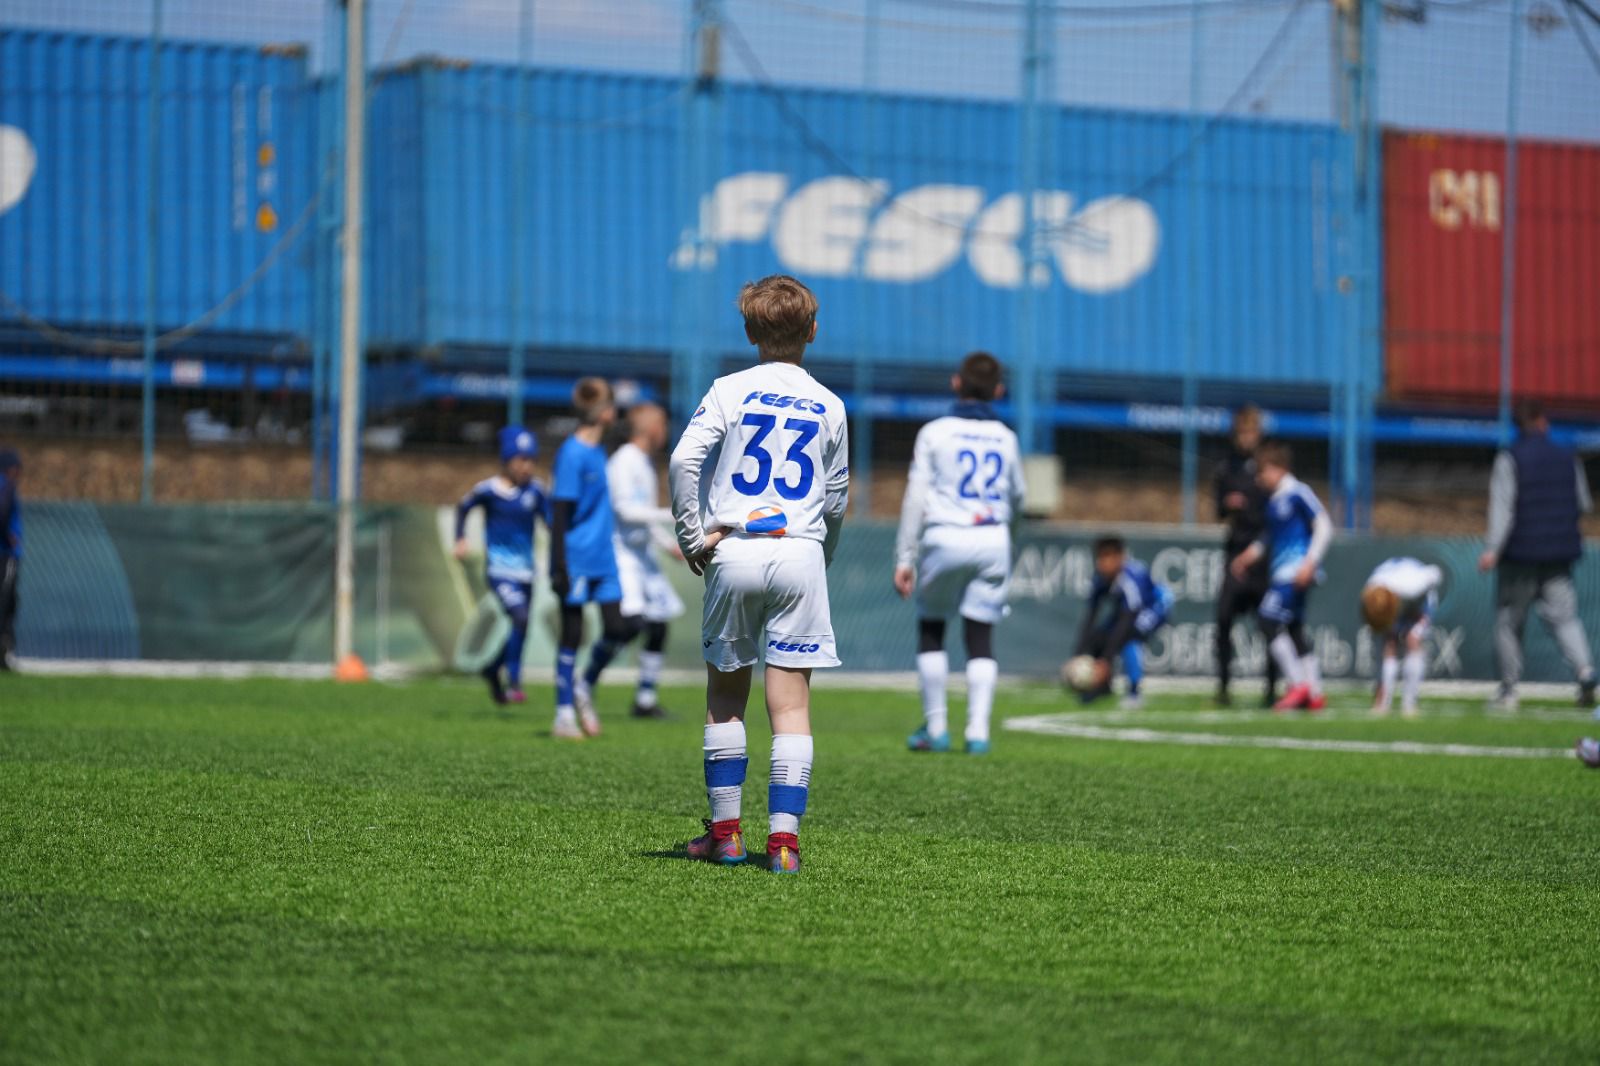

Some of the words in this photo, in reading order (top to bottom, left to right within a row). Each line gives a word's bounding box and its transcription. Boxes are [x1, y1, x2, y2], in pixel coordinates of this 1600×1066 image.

[668, 171, 1160, 293] FESCO
[743, 391, 826, 415] FESCO
[731, 413, 820, 500] 33
[957, 449, 1003, 500] 22
[768, 640, 820, 653] FESCO
